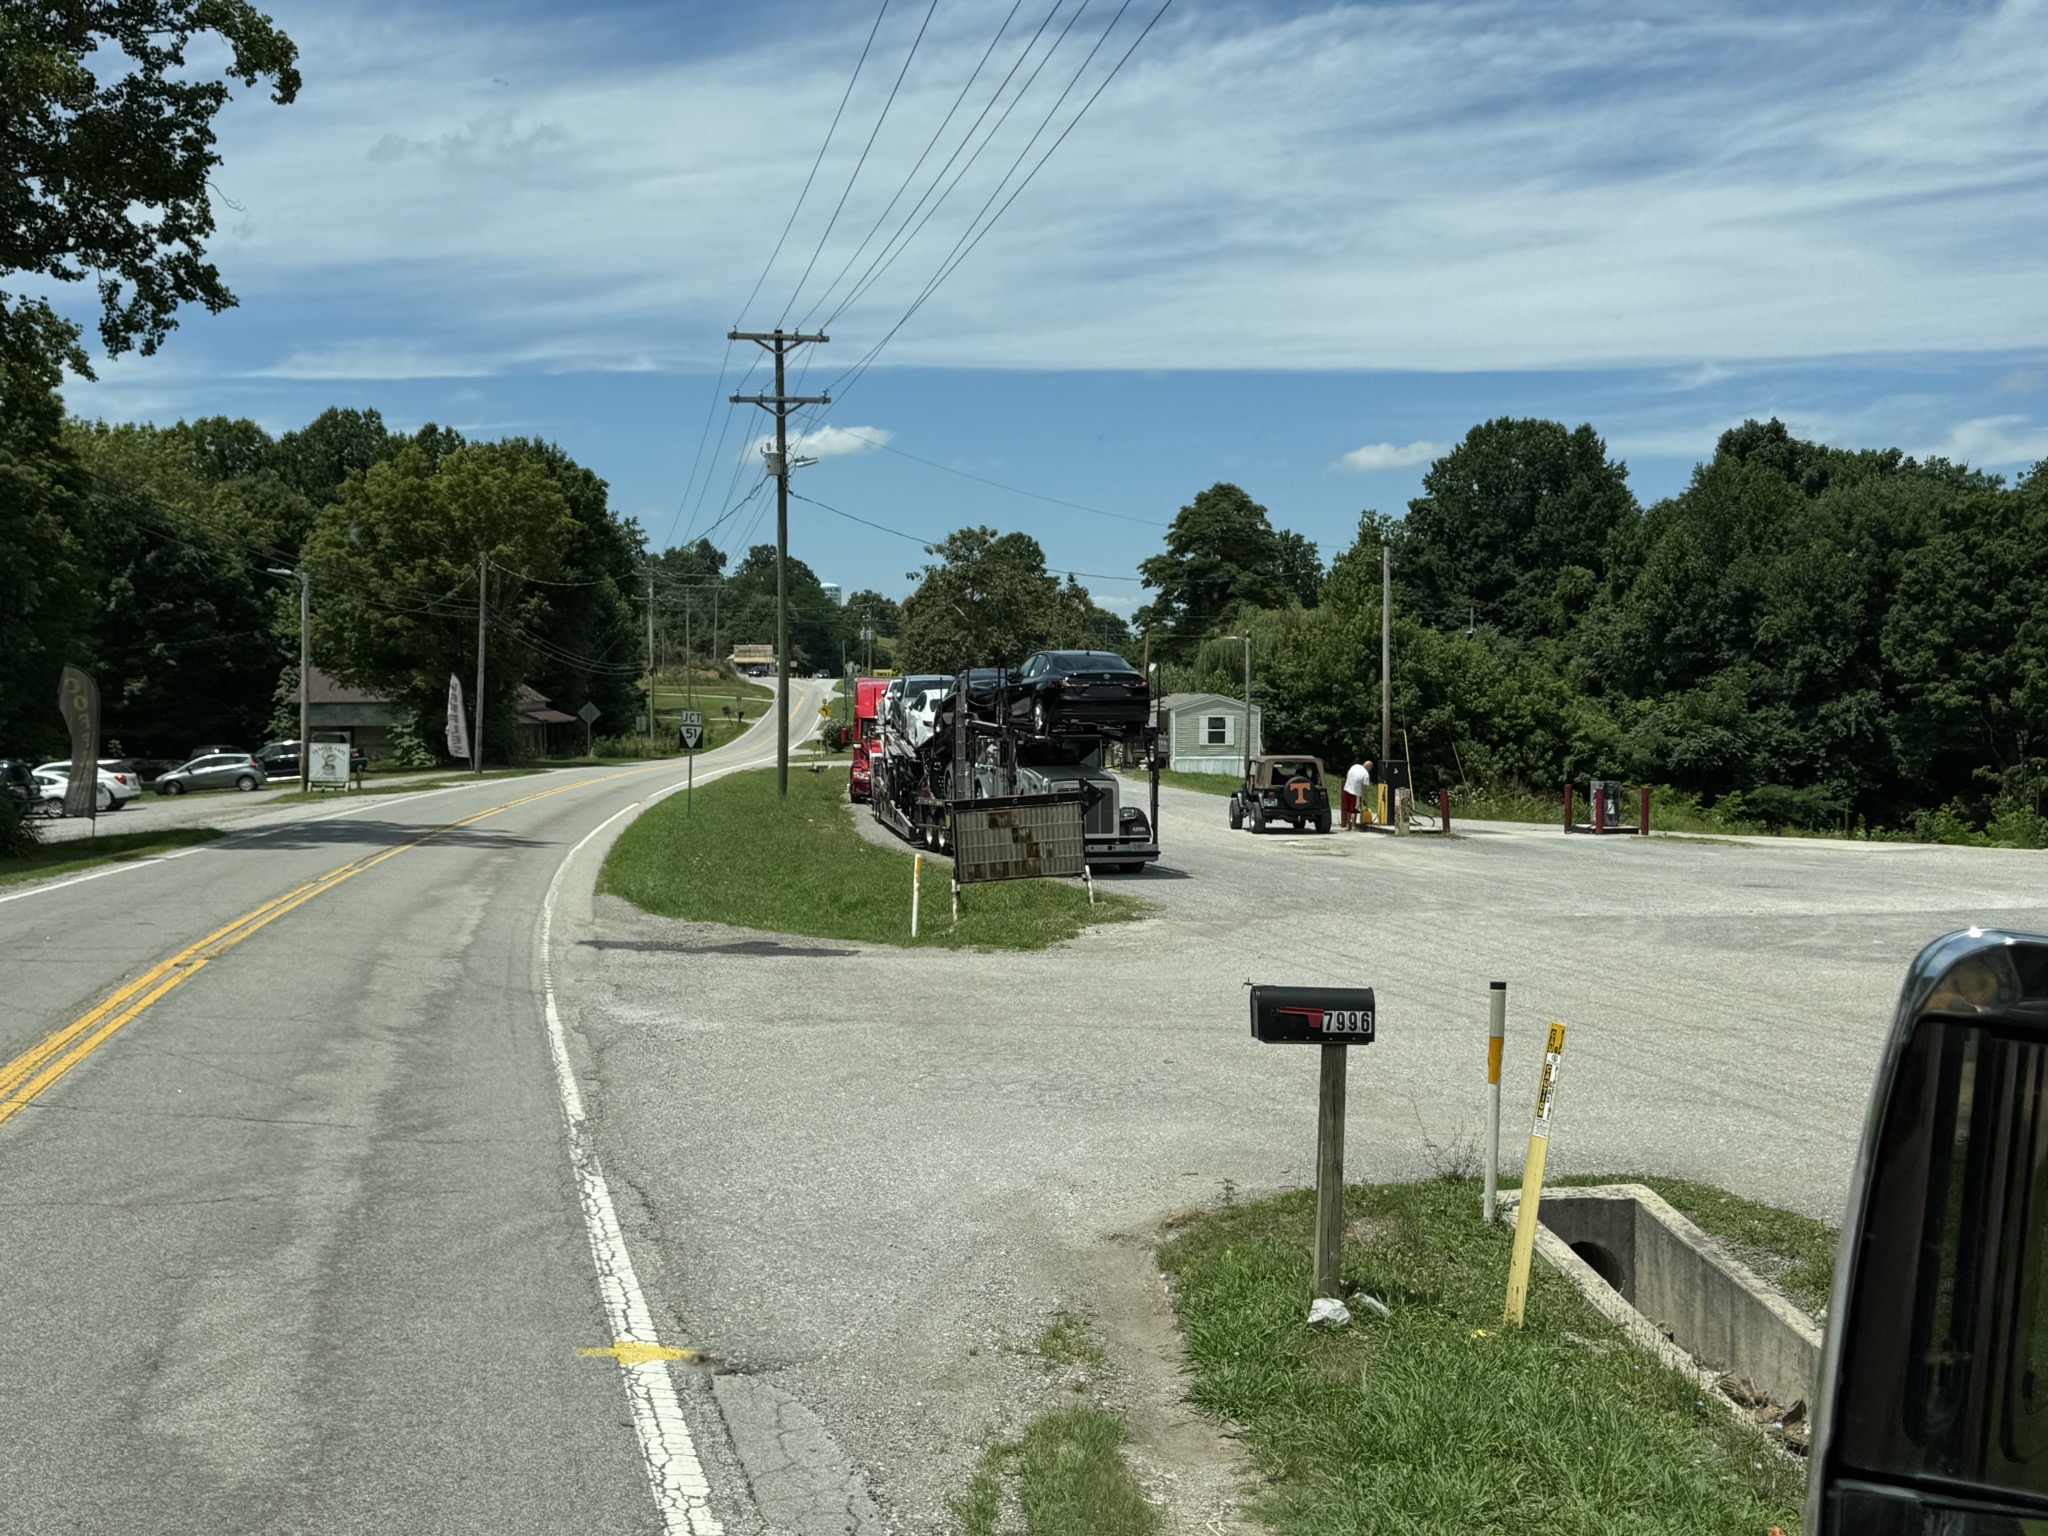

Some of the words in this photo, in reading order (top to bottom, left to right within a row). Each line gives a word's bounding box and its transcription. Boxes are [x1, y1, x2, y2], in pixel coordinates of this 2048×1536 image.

[683, 712, 702, 723] JCT
[685, 728, 697, 739] 51
[1289, 782, 1311, 804] T
[1324, 1012, 1371, 1032] 7996
[1538, 1065, 1552, 1117] CAUTION
